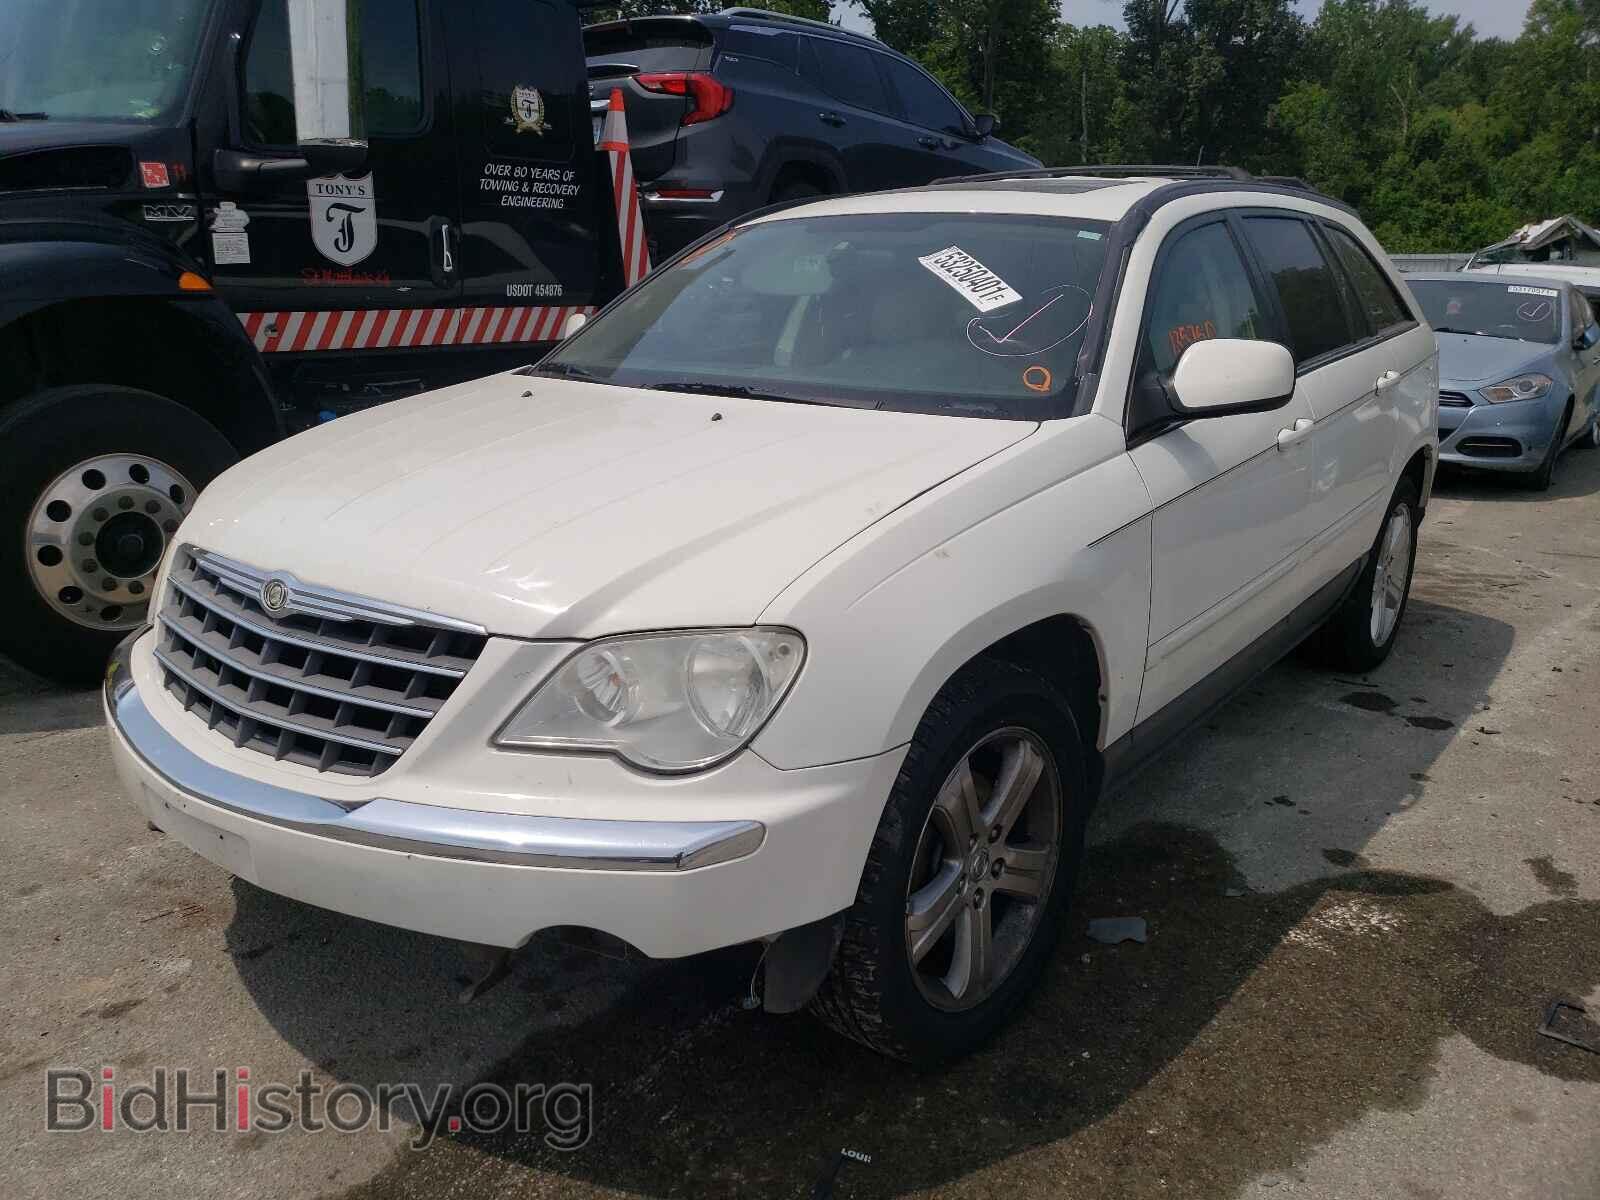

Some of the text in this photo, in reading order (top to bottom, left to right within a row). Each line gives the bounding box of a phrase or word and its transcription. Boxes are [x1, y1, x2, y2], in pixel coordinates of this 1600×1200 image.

[484, 163, 576, 182] OVER 80 YEARS OF
[315, 183, 366, 196] TONY'S
[480, 178, 580, 196] TOWING & RECOVERY
[501, 195, 564, 209] ENGINEERING
[506, 284, 534, 297] USDOT
